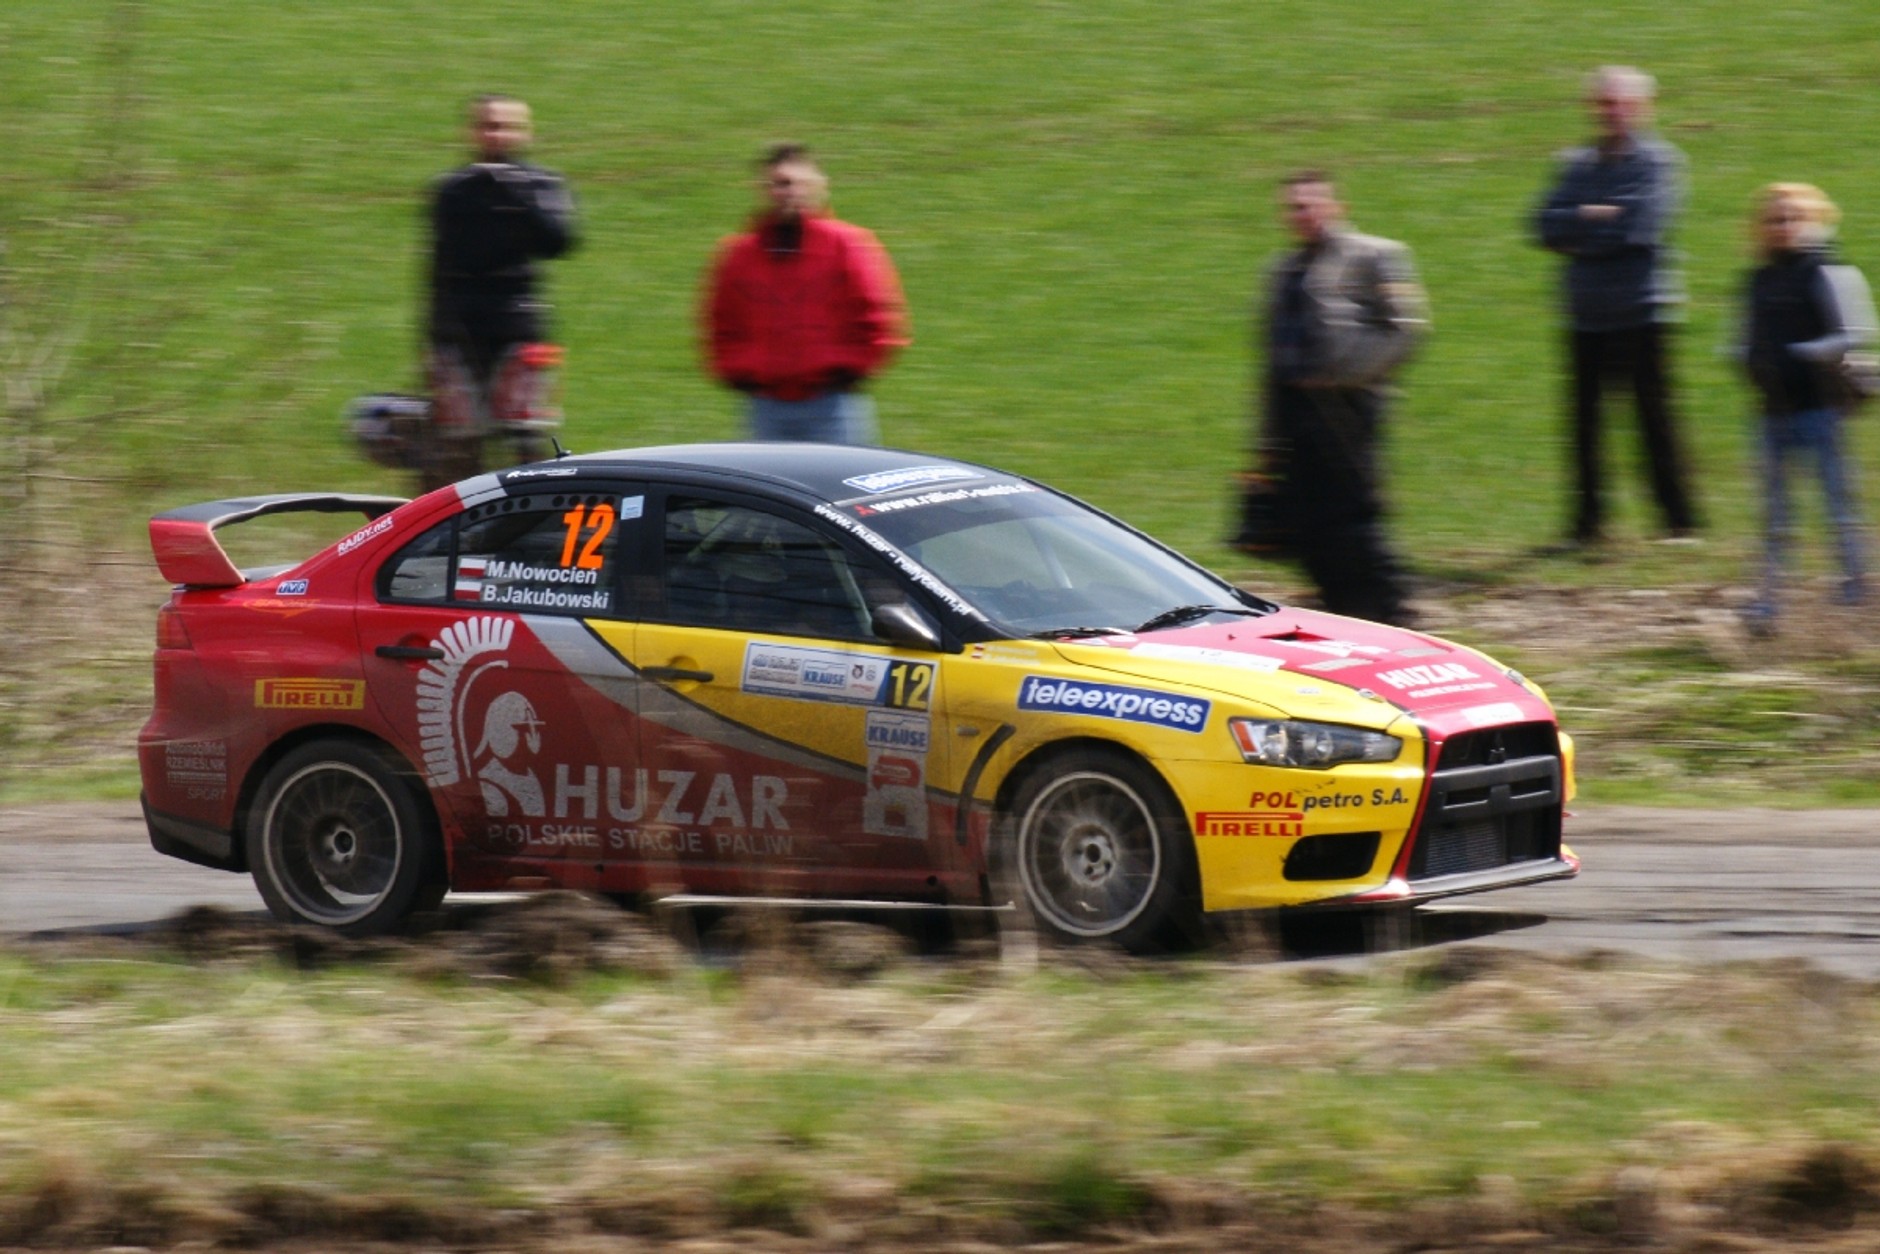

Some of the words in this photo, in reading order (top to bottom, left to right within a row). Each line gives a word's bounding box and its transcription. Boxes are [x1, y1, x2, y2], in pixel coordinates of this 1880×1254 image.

[337, 516, 393, 554] RAJDY.net
[560, 503, 616, 569] 12
[483, 584, 609, 608] B.Jakubowski
[803, 670, 845, 686] KRAUSE
[891, 664, 932, 708] 12
[1375, 662, 1481, 689] HUZAR
[263, 681, 355, 706] PIRELLI
[1026, 678, 1204, 726] teleexpress
[868, 725, 926, 747] KRAUSE
[554, 763, 790, 830] HUZAR
[1372, 788, 1409, 806] S.A.
[1196, 812, 1304, 837] PIRELLI
[488, 823, 600, 847] POLSKIE
[610, 827, 704, 852] STACJE
[715, 831, 795, 856] PALIW
